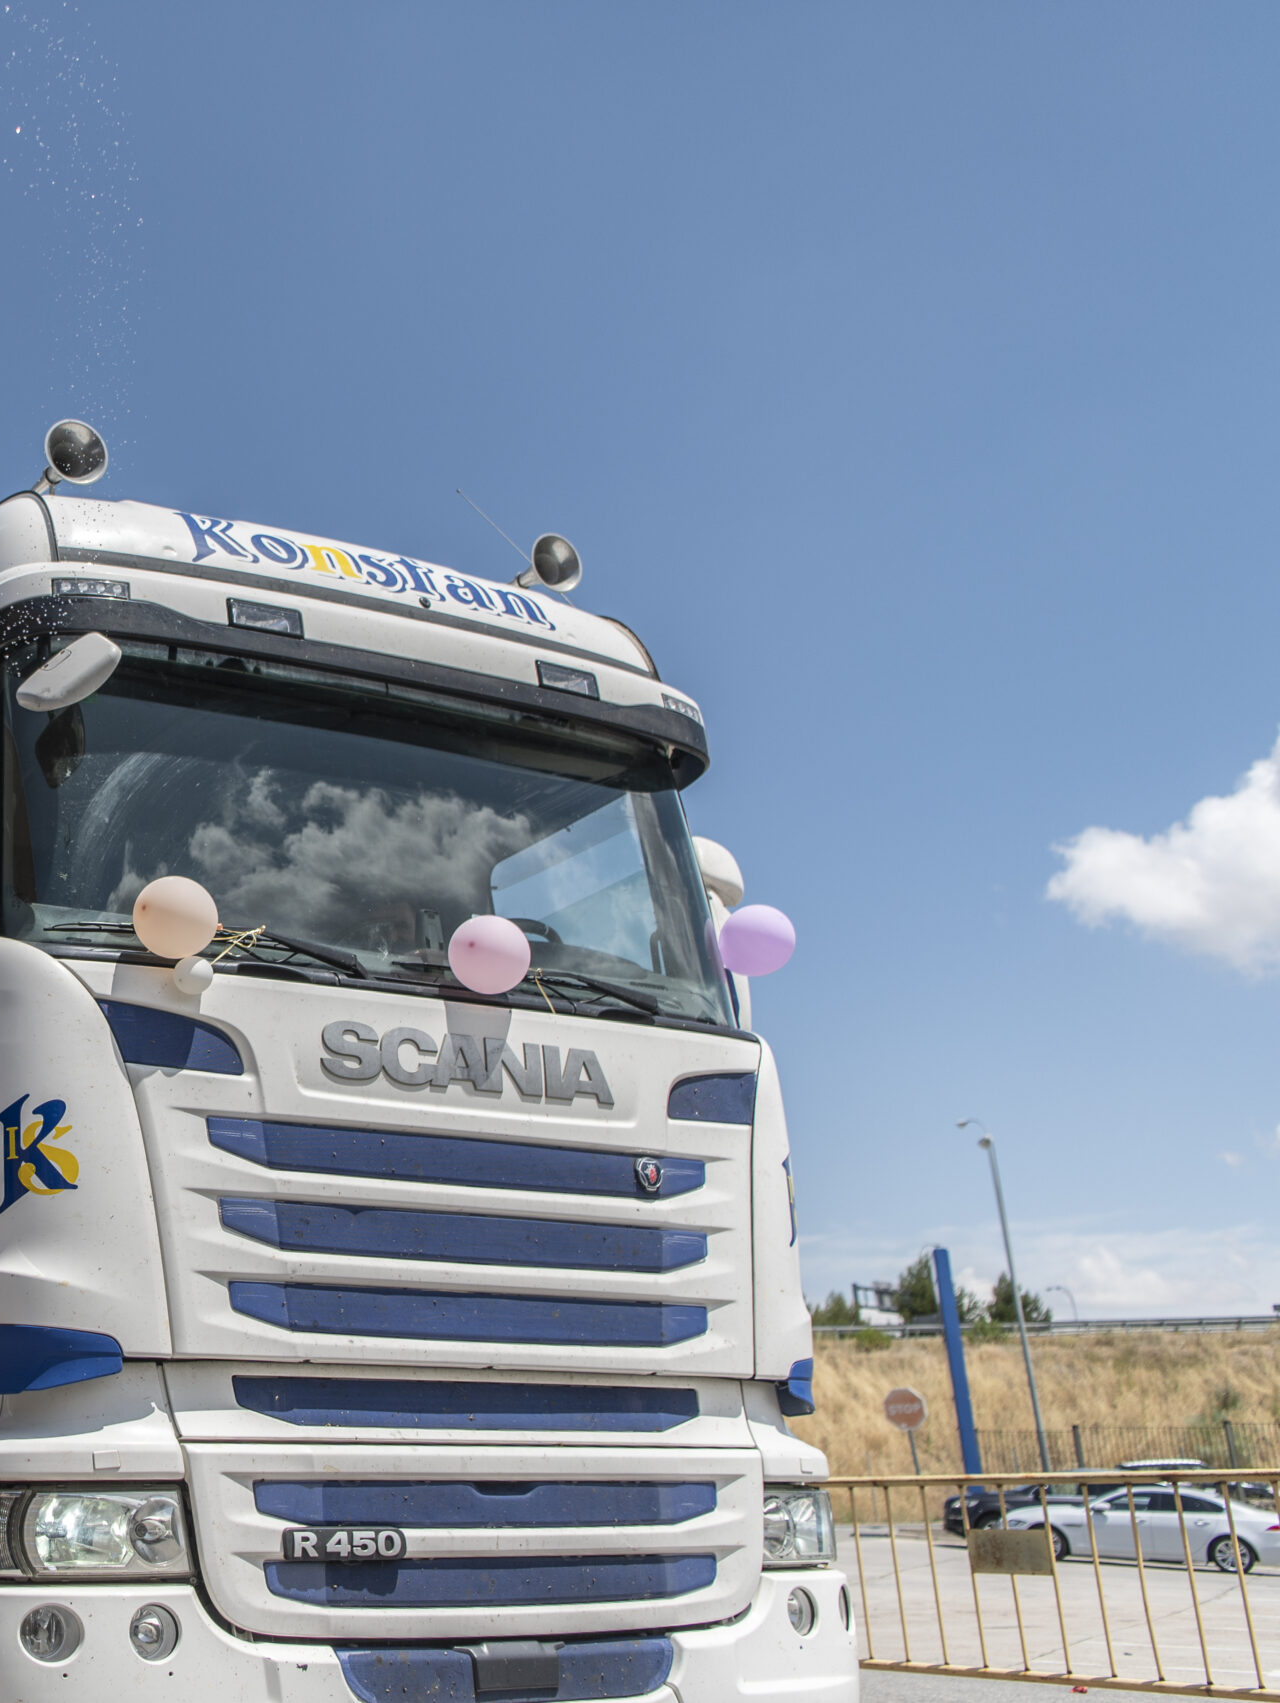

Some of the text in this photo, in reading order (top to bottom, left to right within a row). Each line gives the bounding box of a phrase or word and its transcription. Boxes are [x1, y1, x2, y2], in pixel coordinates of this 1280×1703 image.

[173, 510, 556, 631] Konstan
[320, 1020, 616, 1109] SCANIA
[888, 1403, 920, 1416] STOP
[293, 1530, 402, 1558] R 450
